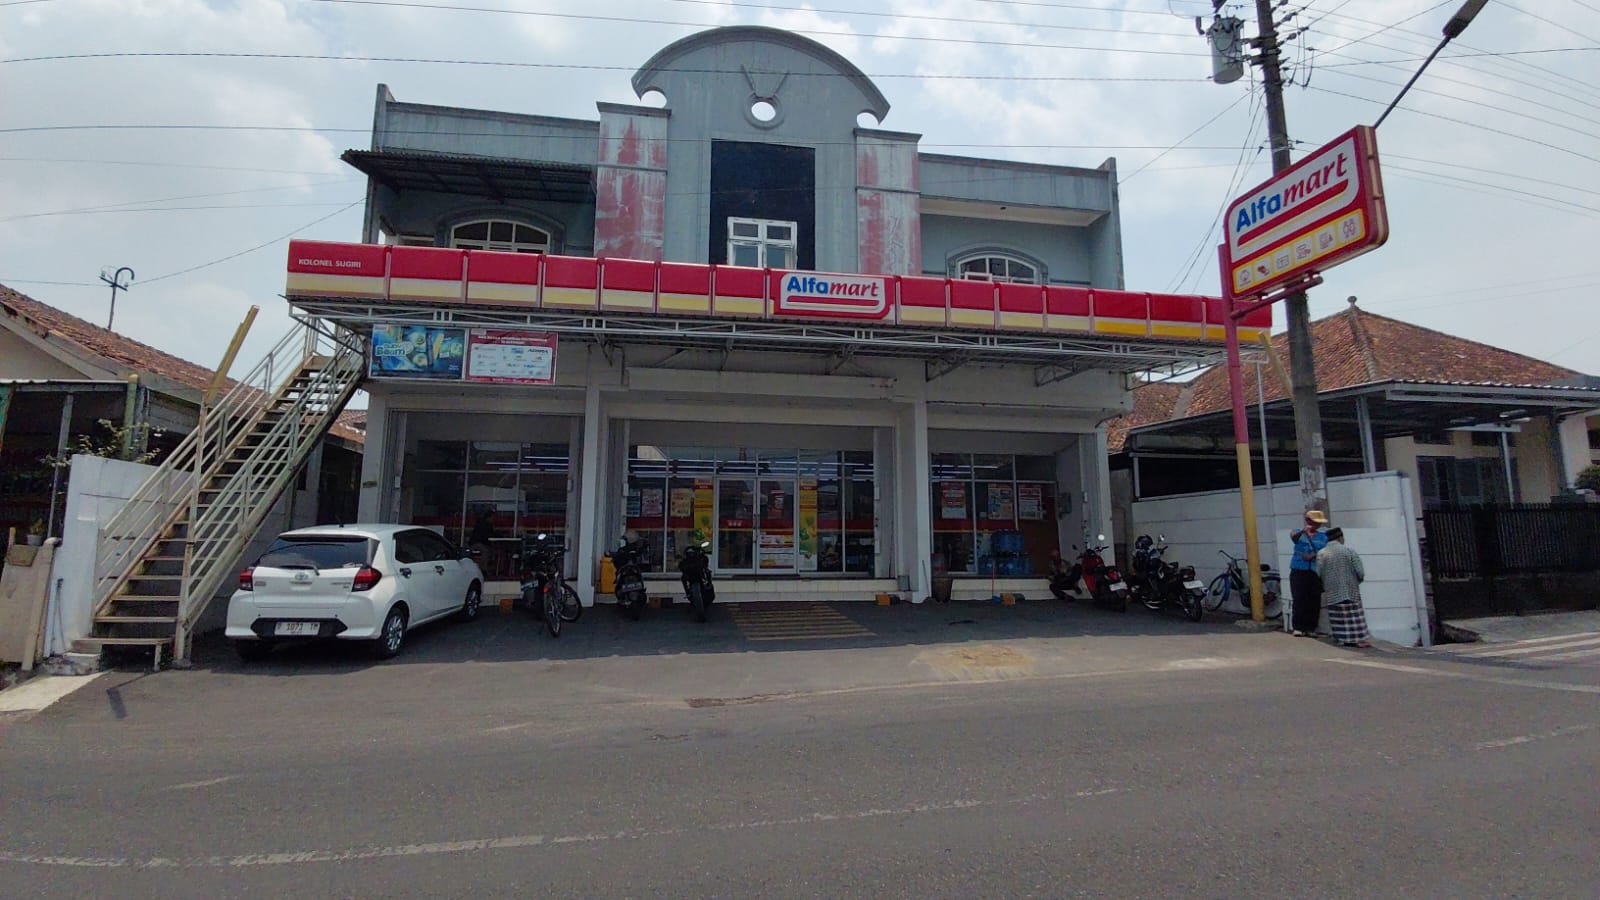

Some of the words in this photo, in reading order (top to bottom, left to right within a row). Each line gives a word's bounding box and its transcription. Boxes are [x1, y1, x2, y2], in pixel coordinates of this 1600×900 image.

[1236, 152, 1348, 232] Alfamart
[299, 258, 333, 267] KOLONEL
[335, 260, 361, 269] SUGIRI
[787, 275, 879, 297] Alfamart
